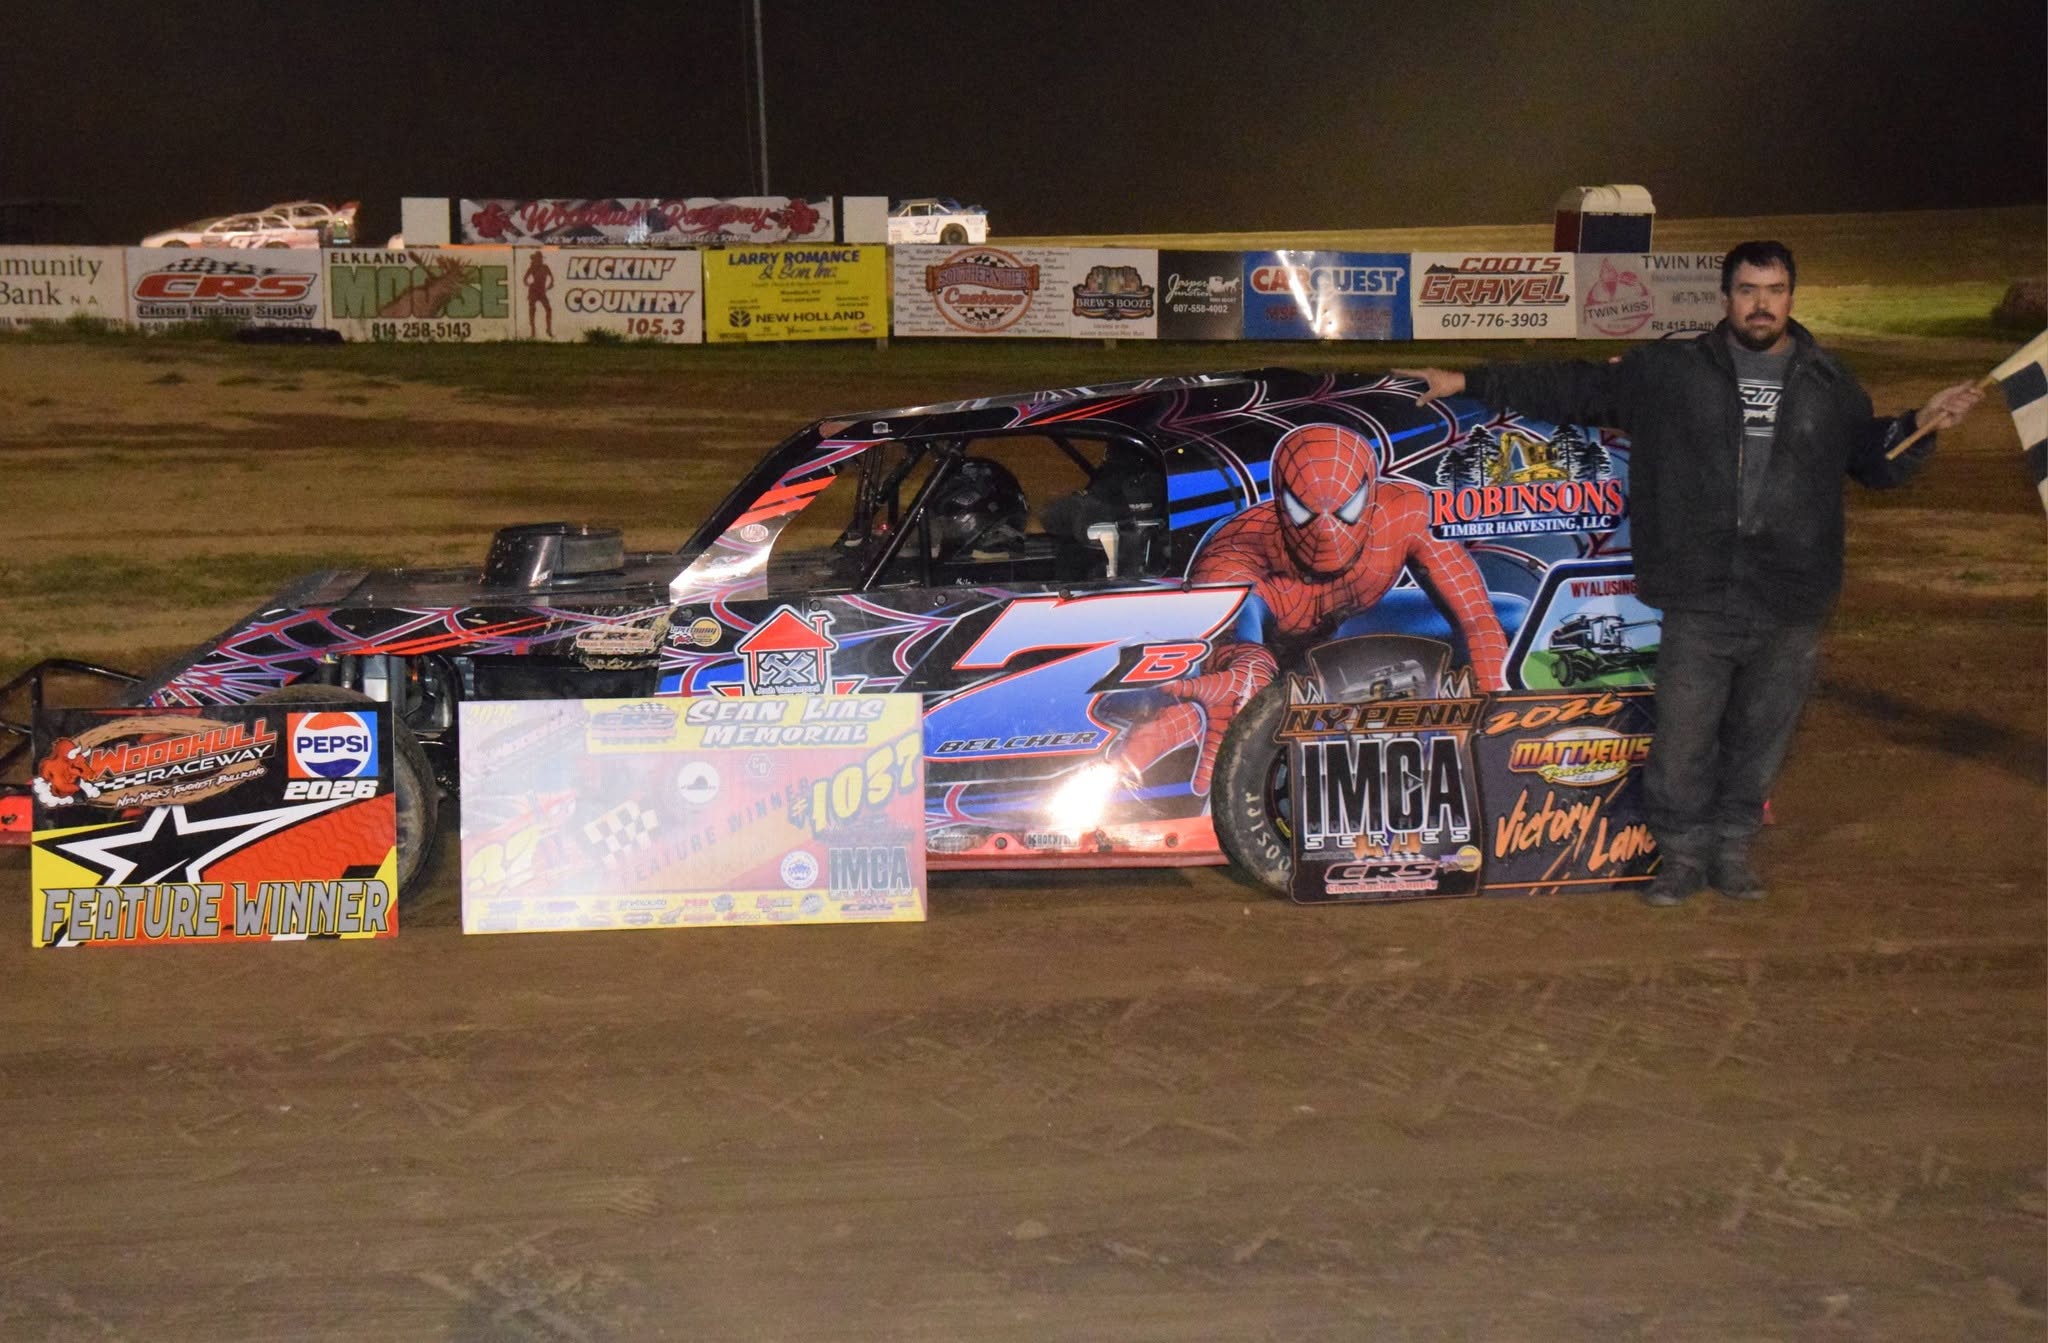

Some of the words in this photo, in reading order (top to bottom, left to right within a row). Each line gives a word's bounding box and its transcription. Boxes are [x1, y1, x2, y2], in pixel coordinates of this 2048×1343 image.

[330, 252, 406, 264] ELKLAND
[566, 256, 675, 281] KICKIN'
[729, 253, 779, 265] LARRY
[784, 250, 860, 264] ROMANCE
[1458, 256, 1562, 273] COOTS
[1641, 255, 1690, 270] TWIN
[1696, 255, 1725, 270] KIS
[0, 255, 103, 285] munity
[939, 265, 999, 284] SOUTHERN
[1000, 268, 1028, 286] TIER
[1251, 267, 1399, 293] CARQUEST
[135, 273, 316, 301] CRS
[330, 265, 510, 319] MOOSE
[1419, 275, 1570, 306] GRAVEL
[255, 304, 316, 319] Supply
[565, 289, 695, 314] COUNTRY
[1076, 298, 1114, 308] BREW'S
[1116, 298, 1151, 308] BOOZE
[1587, 306, 1619, 319] TWIN
[1621, 301, 1649, 314] KISS
[626, 318, 685, 335] 105.3
[756, 312, 789, 323] NEW
[794, 310, 865, 322] HOLLAND
[1441, 313, 1548, 328] 607-776-3903
[1652, 321, 1665, 331] Rt
[1667, 321, 1688, 332] 415
[372, 322, 472, 339] 814-258-5143
[1432, 479, 1624, 526] ROBINSONS
[1441, 521, 1493, 537] TIMBER
[1496, 517, 1581, 535] HARVESTING,
[1583, 515, 1612, 528] LLC
[686, 700, 784, 724] SEAN
[801, 699, 884, 721] LIAS
[1486, 693, 1624, 734] 2026
[297, 735, 369, 753] PEPSI
[701, 724, 867, 746] MEMORIAL
[934, 730, 1098, 754] BELCHER
[91, 719, 277, 777] WOODHULL
[1512, 737, 1653, 767] MATTHEWS
[145, 744, 273, 783] RACEWAY
[116, 793, 138, 807] NEW
[171, 778, 215, 796] TOUGHEST
[216, 766, 267, 785] BULLRING
[283, 779, 380, 800] 2026
[1302, 736, 1471, 838] IMCA
[1495, 788, 1602, 862] Victory
[1305, 829, 1471, 850] SERIES
[829, 846, 912, 891] IMCA
[1324, 861, 1441, 883] CRS
[41, 882, 225, 943] FEATURE
[232, 878, 392, 939] WINNER
